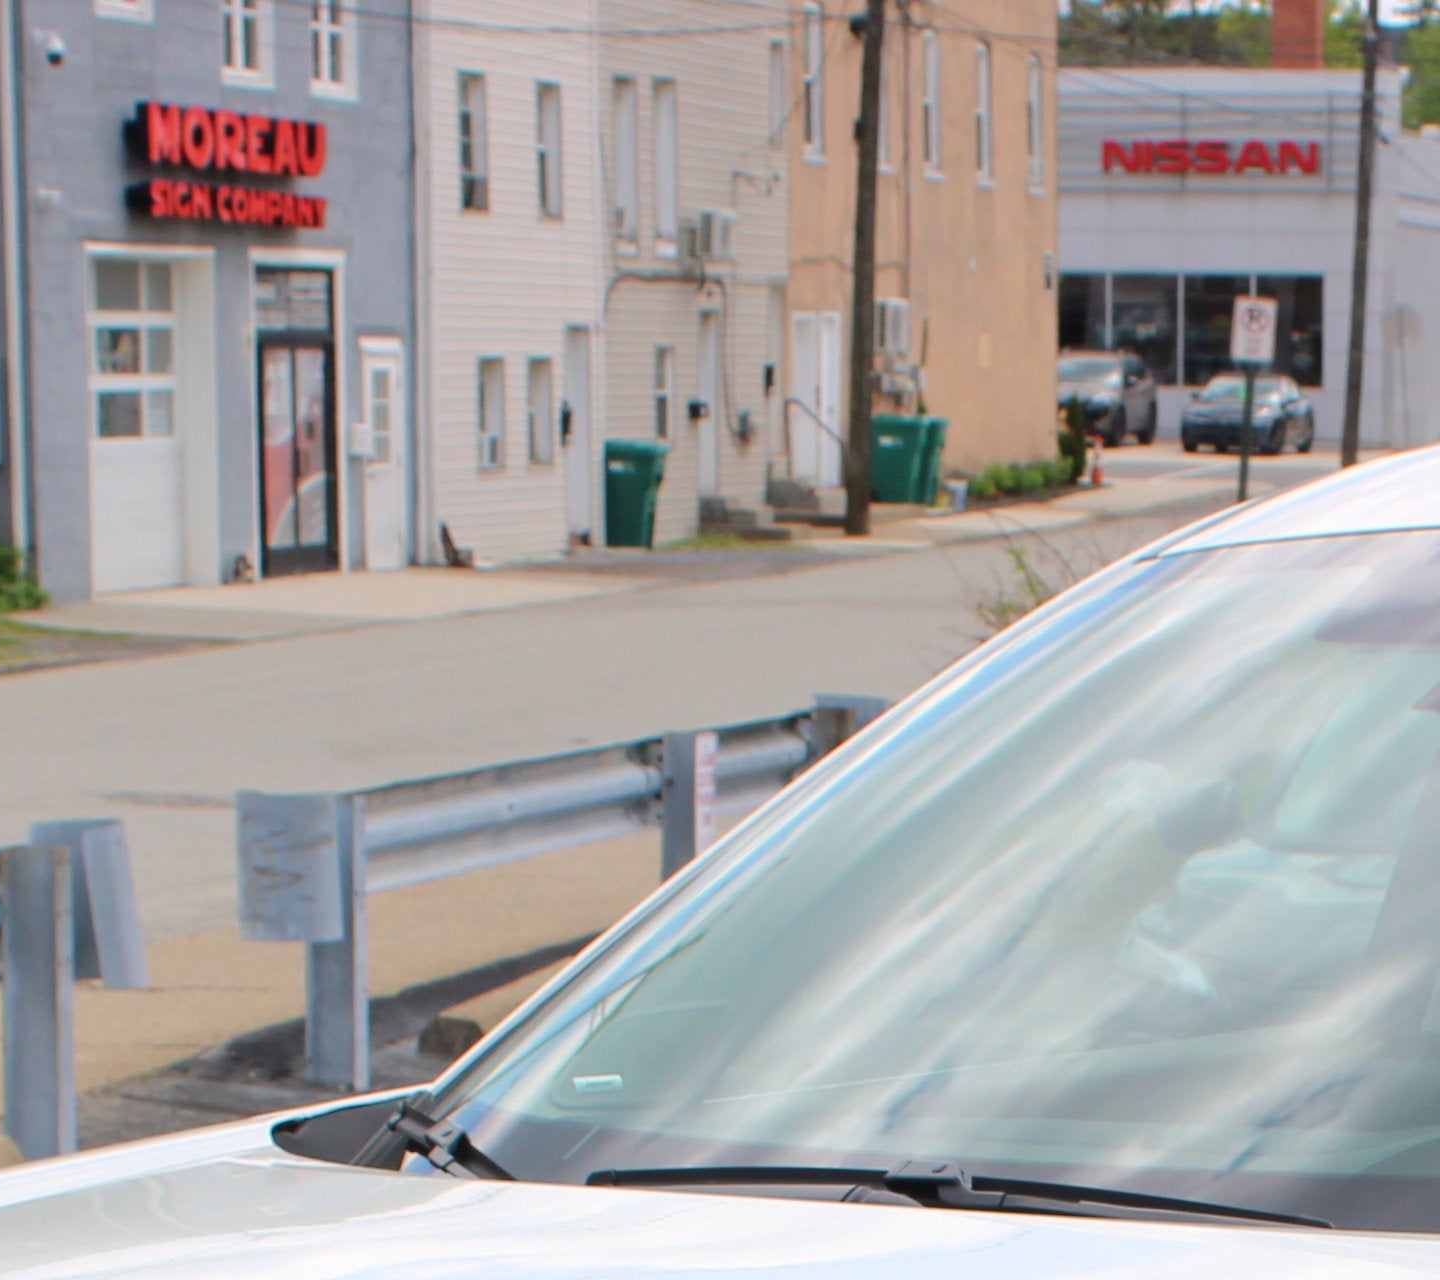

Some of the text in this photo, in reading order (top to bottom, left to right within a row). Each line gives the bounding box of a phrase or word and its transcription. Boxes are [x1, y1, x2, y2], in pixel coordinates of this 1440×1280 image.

[147, 101, 326, 176] MOREAU
[1101, 138, 1319, 174] NISSAN
[150, 178, 326, 228] SIGN COMPANY
